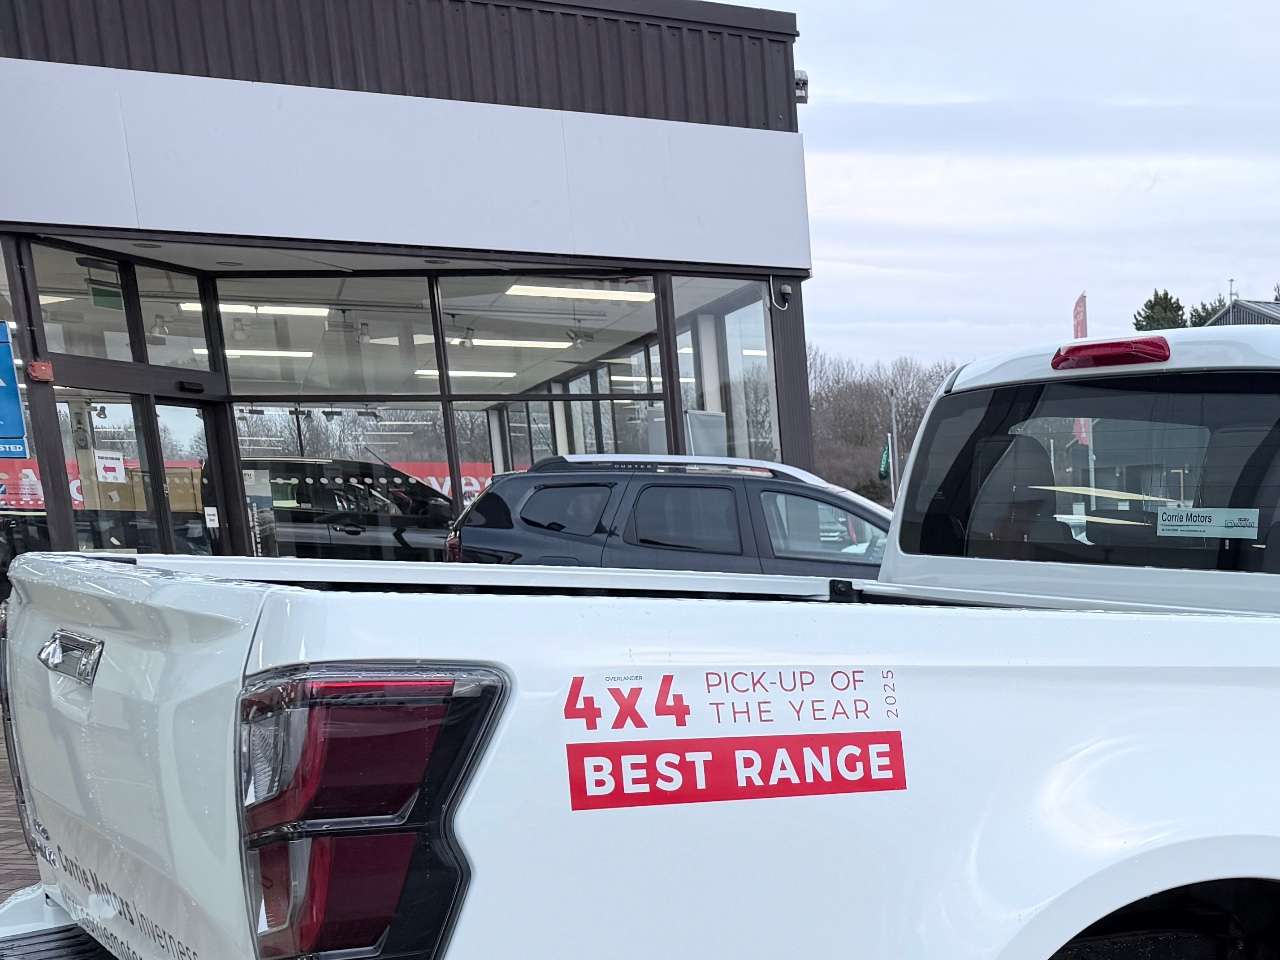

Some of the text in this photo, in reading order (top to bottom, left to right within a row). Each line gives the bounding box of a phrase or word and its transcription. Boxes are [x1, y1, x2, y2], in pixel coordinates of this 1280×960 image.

[1161, 512, 1212, 523] Corrie Motors
[705, 669, 865, 694] PICK-UP OF
[881, 669, 900, 719] 2025
[708, 698, 871, 724] THE YEAR
[583, 743, 895, 797] BEST RANGE
[57, 845, 92, 893] Corrie
[88, 868, 135, 926] Motors
